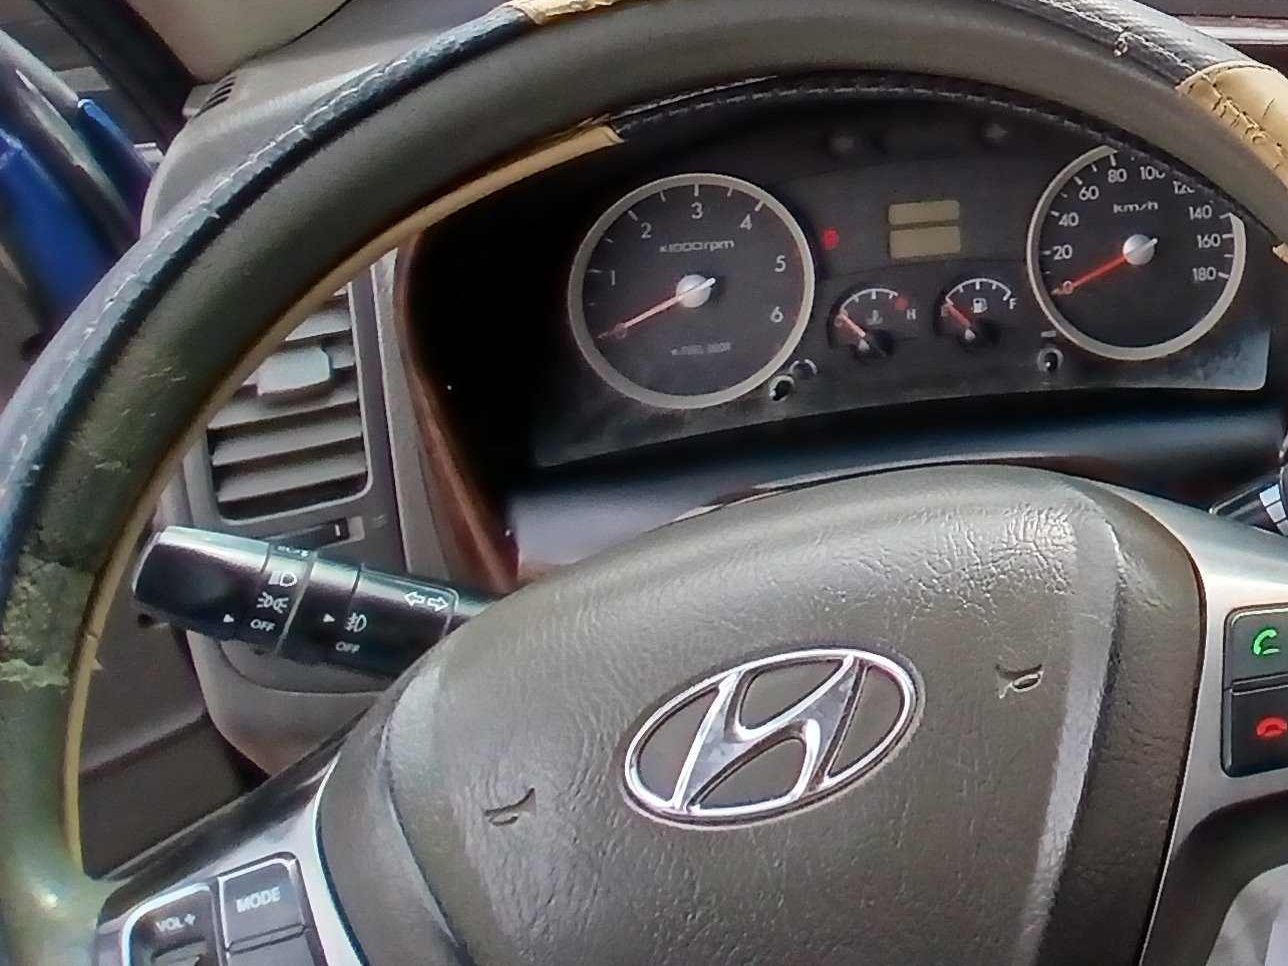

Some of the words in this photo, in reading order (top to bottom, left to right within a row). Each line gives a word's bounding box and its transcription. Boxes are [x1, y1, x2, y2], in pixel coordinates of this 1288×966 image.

[1107, 168, 1127, 183] 80
[1079, 185, 1099, 201] 60
[691, 202, 703, 219] 3
[1113, 201, 1159, 214] km/h
[1189, 204, 1212, 220] 140
[740, 214, 752, 230] 4
[1058, 212, 1079, 227] 40
[641, 222, 652, 239] 2
[1197, 234, 1221, 249] 160
[1053, 244, 1073, 260] 20
[774, 255, 786, 273] 5
[1192, 266, 1216, 282] 180
[1009, 298, 1017, 310] F
[770, 306, 784, 323] 6
[251, 619, 276, 632] OFF
[335, 641, 360, 654] OFF
[235, 886, 281, 913] MODE
